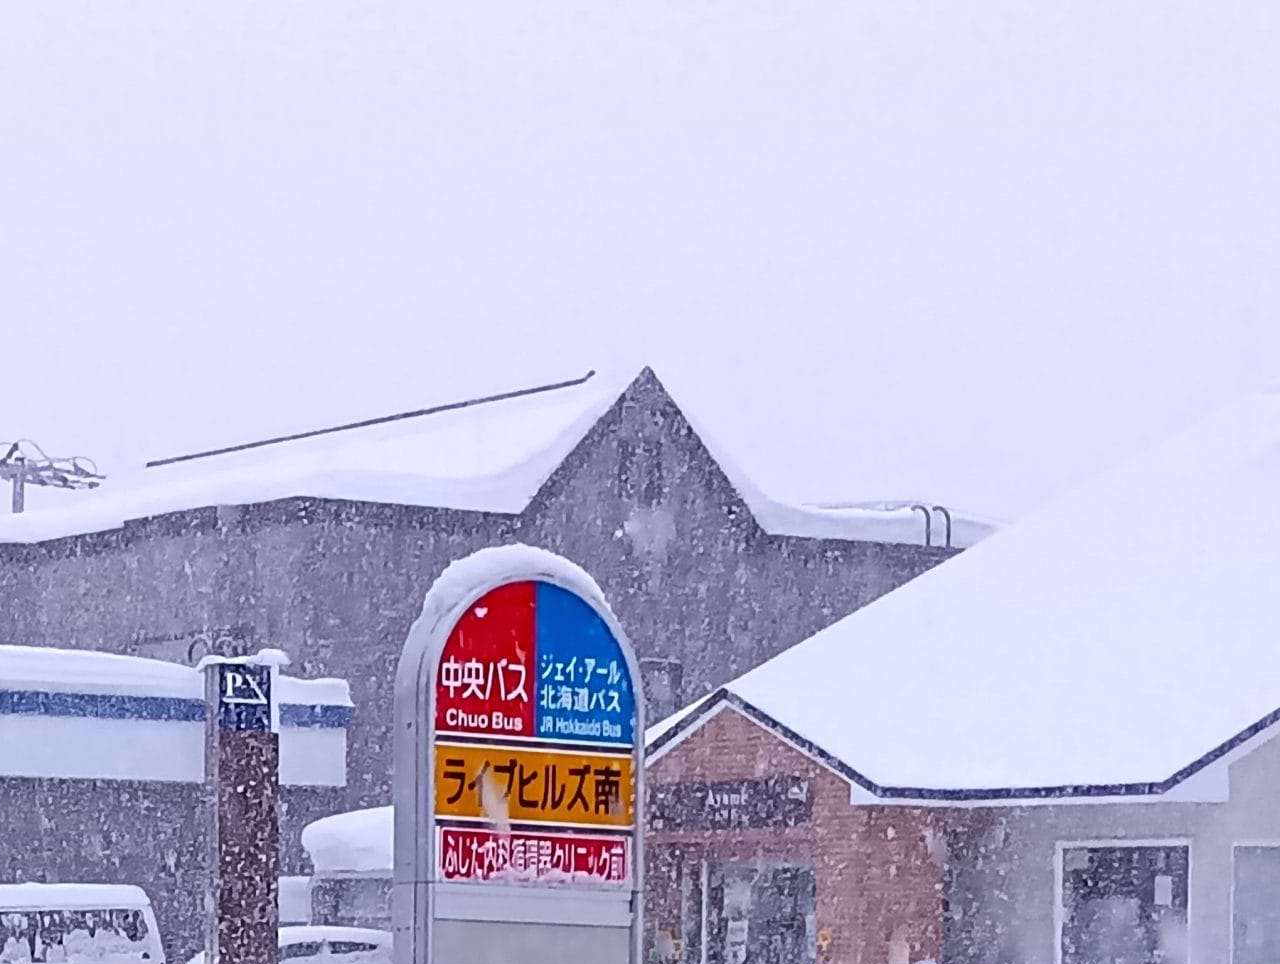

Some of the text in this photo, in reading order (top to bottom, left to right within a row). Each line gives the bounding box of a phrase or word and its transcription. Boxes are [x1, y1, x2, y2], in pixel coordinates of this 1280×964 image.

[441, 655, 528, 702] 中央バス
[540, 684, 621, 713] 北海道バス
[446, 708, 523, 731] Chuo Bus
[540, 716, 622, 737] JR Hokkaido Bus
[443, 759, 622, 815] ライブヒルズ南
